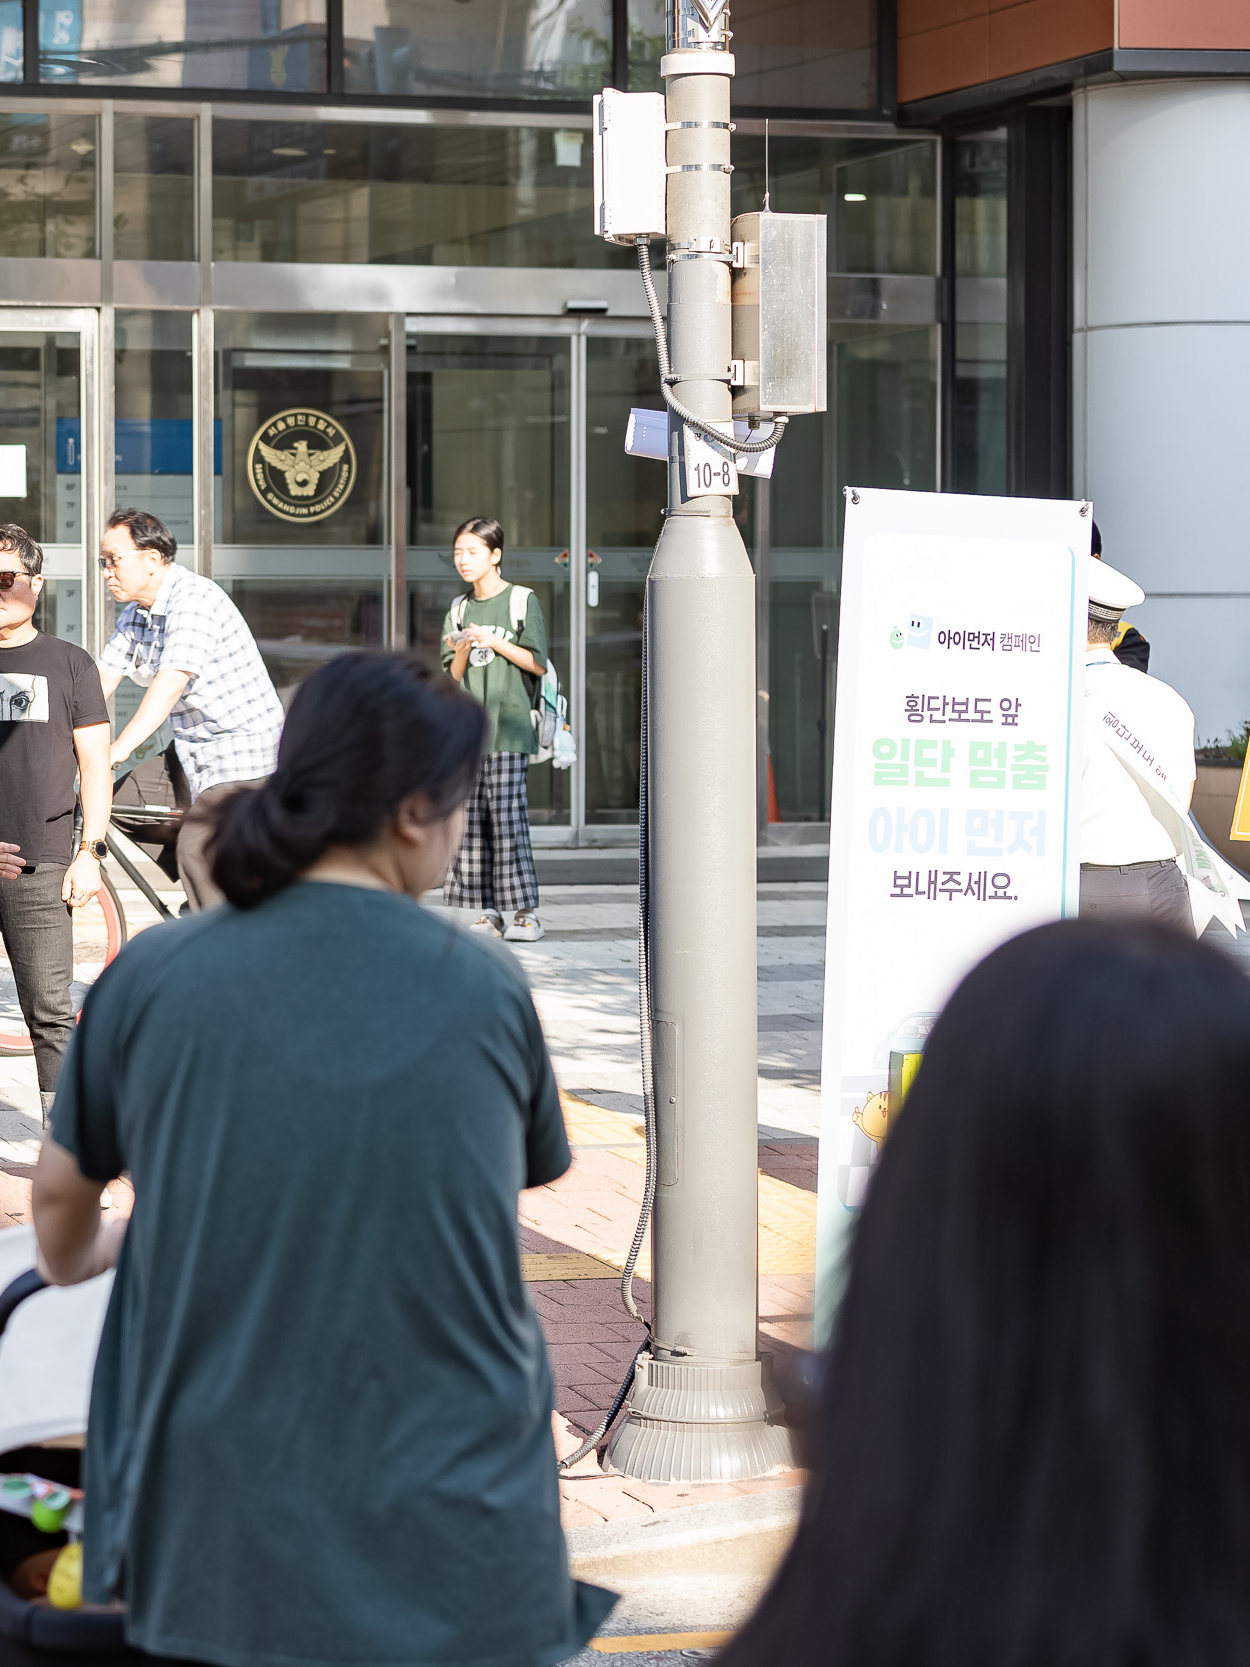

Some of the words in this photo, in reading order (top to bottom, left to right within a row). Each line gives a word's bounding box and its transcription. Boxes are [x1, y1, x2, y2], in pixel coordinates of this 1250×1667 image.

[267, 414, 336, 437] 서울광진경찰서
[267, 492, 308, 514] GWANGJIN
[333, 463, 349, 498] STATION
[694, 461, 730, 488] 10-8
[937, 629, 996, 651] 아이먼저
[999, 632, 1041, 653] 캠페인
[904, 693, 994, 724] 횡단보도
[999, 697, 1022, 727] 앞
[872, 737, 955, 787] 일단
[968, 740, 1050, 791] 멈춤
[868, 806, 950, 855] 아이
[965, 808, 1047, 857] 먼저
[890, 869, 1018, 901] 보내주세요.
